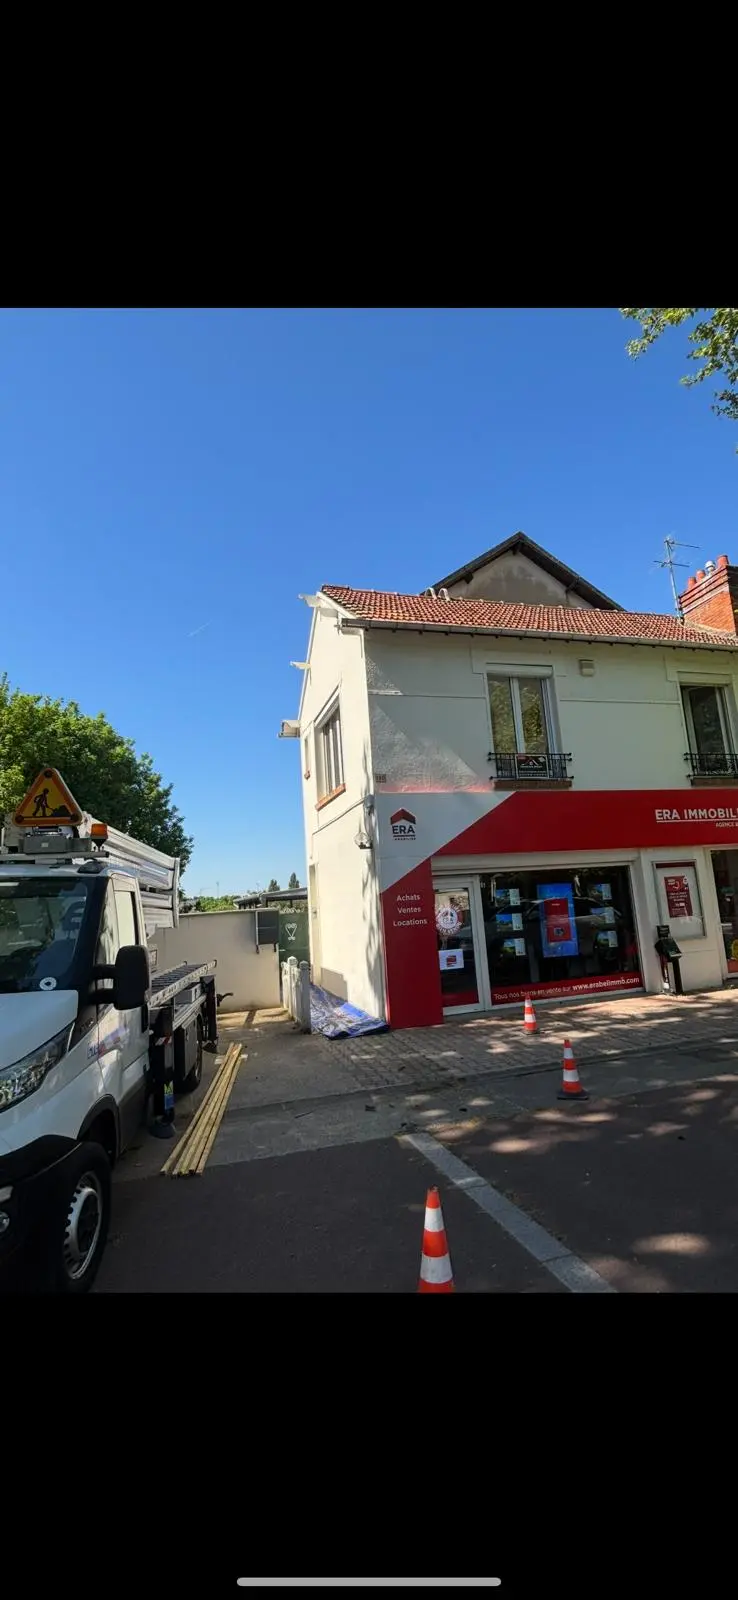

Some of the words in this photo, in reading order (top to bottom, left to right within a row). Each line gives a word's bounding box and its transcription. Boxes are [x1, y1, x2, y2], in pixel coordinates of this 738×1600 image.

[655, 809, 680, 820] ERA
[392, 825, 415, 834] ERA
[392, 919, 428, 927] Locations
